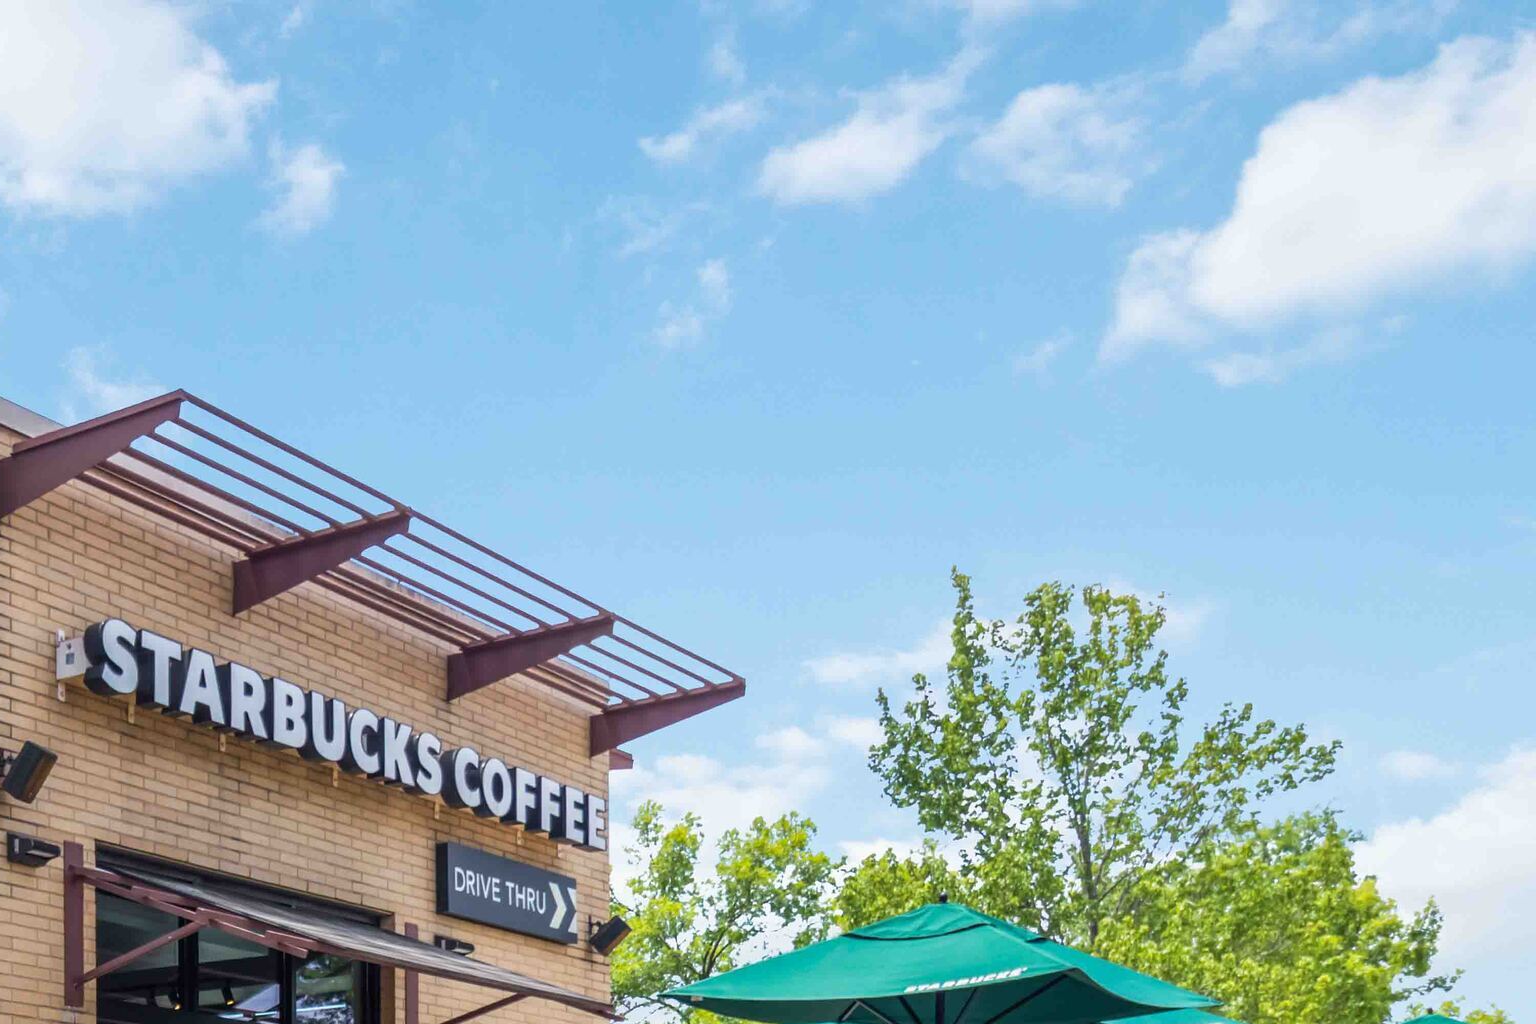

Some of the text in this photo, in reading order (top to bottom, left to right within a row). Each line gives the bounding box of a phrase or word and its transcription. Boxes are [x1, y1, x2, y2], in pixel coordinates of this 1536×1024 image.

[101, 618, 606, 850] STARBUCKS COFFEE
[454, 866, 546, 915] DRIVE THRU
